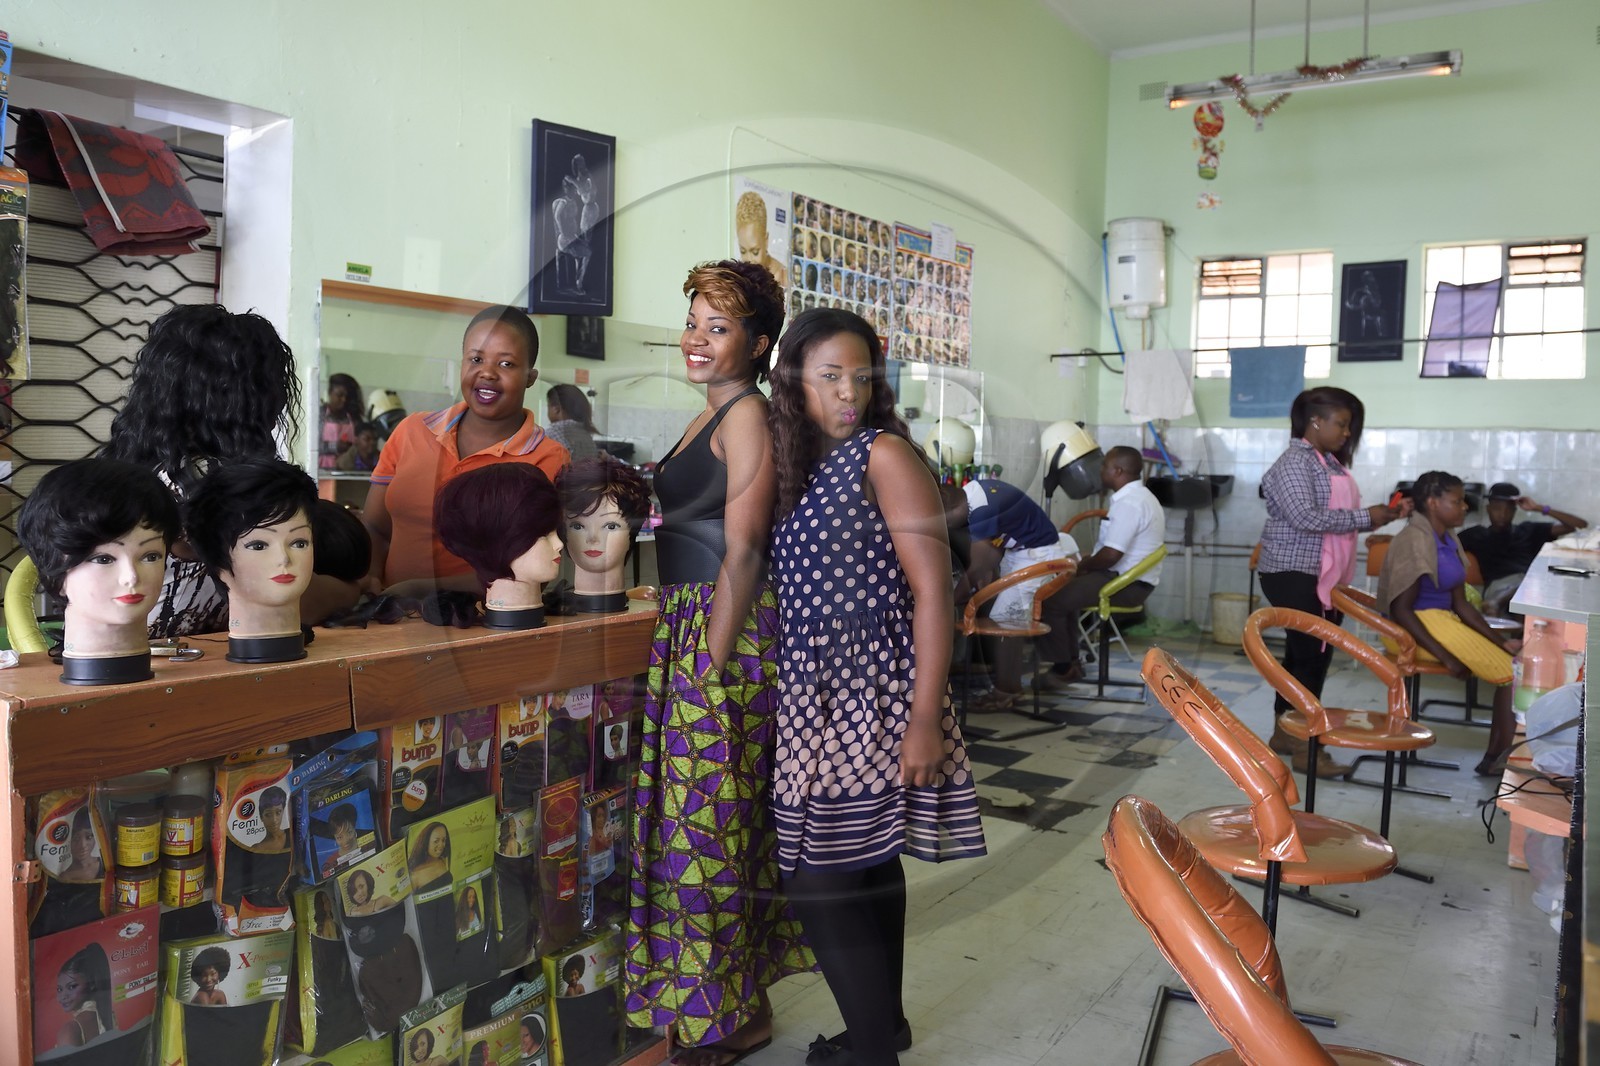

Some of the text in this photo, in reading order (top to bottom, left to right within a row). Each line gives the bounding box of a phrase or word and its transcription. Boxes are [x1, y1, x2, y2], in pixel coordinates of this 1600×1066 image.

[508, 720, 540, 739] bump
[401, 743, 437, 763] bump
[302, 757, 327, 779] DARLING
[324, 786, 353, 805] DARLING
[411, 784, 426, 796] bump
[232, 816, 259, 831] Femi
[246, 826, 265, 836] 28pcs
[470, 1014, 516, 1039] PREMIUM
